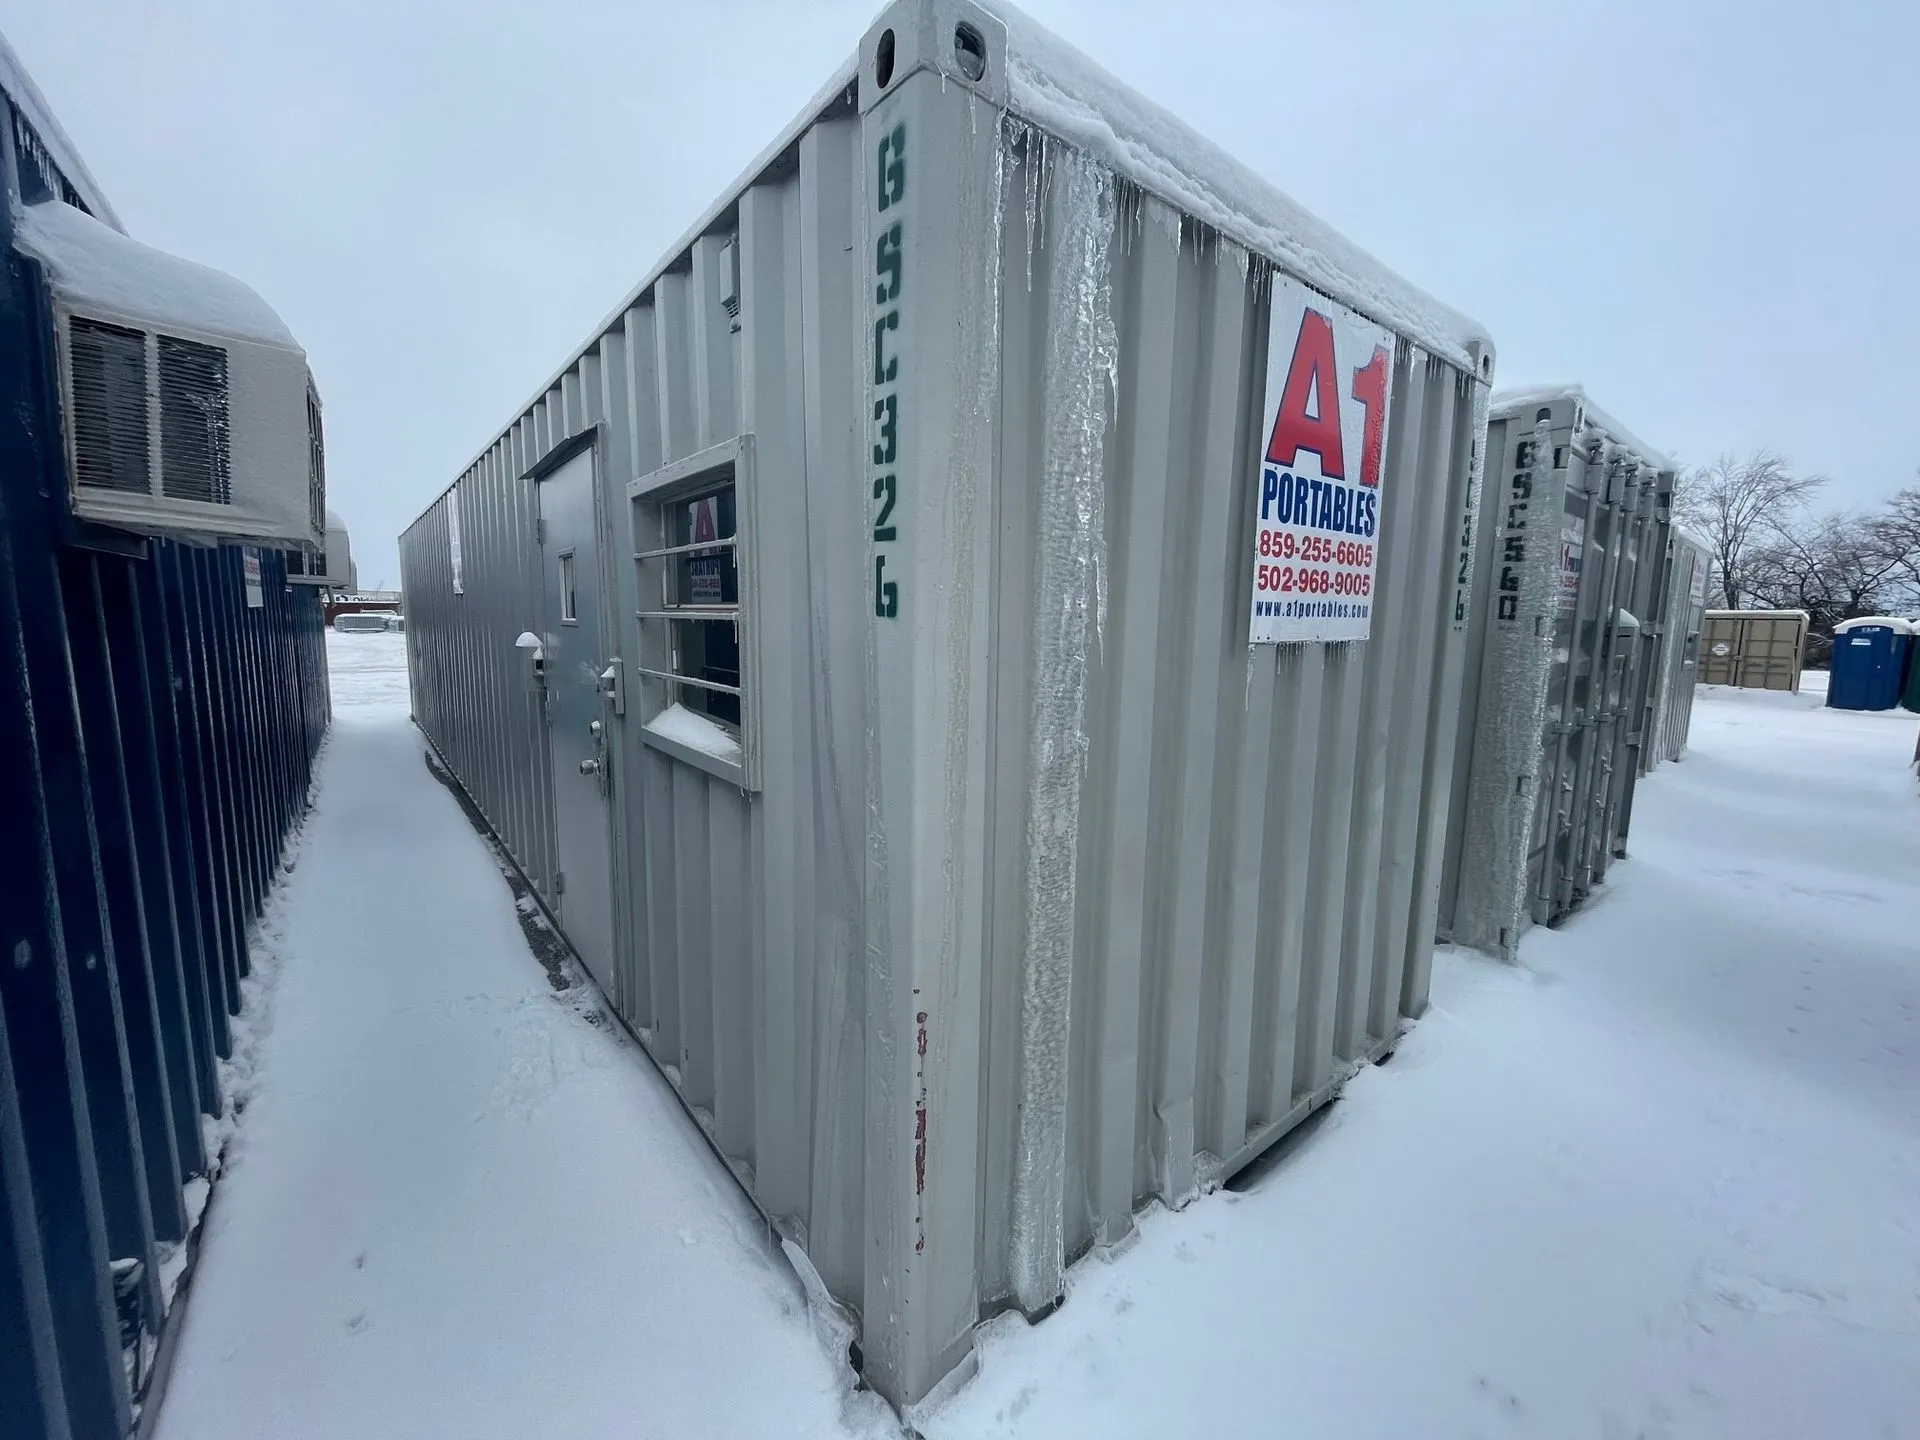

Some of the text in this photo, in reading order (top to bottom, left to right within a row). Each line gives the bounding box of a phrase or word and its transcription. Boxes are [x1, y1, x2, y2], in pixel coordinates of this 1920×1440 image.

[874, 118, 907, 618] GSC326
[1265, 306, 1390, 488] A1
[1261, 467, 1377, 538] PORTABLES
[1259, 529, 1373, 568] 859-255-6605
[1257, 564, 1371, 597] 502-968-9005
[1255, 599, 1369, 619] www.a1portables.com
